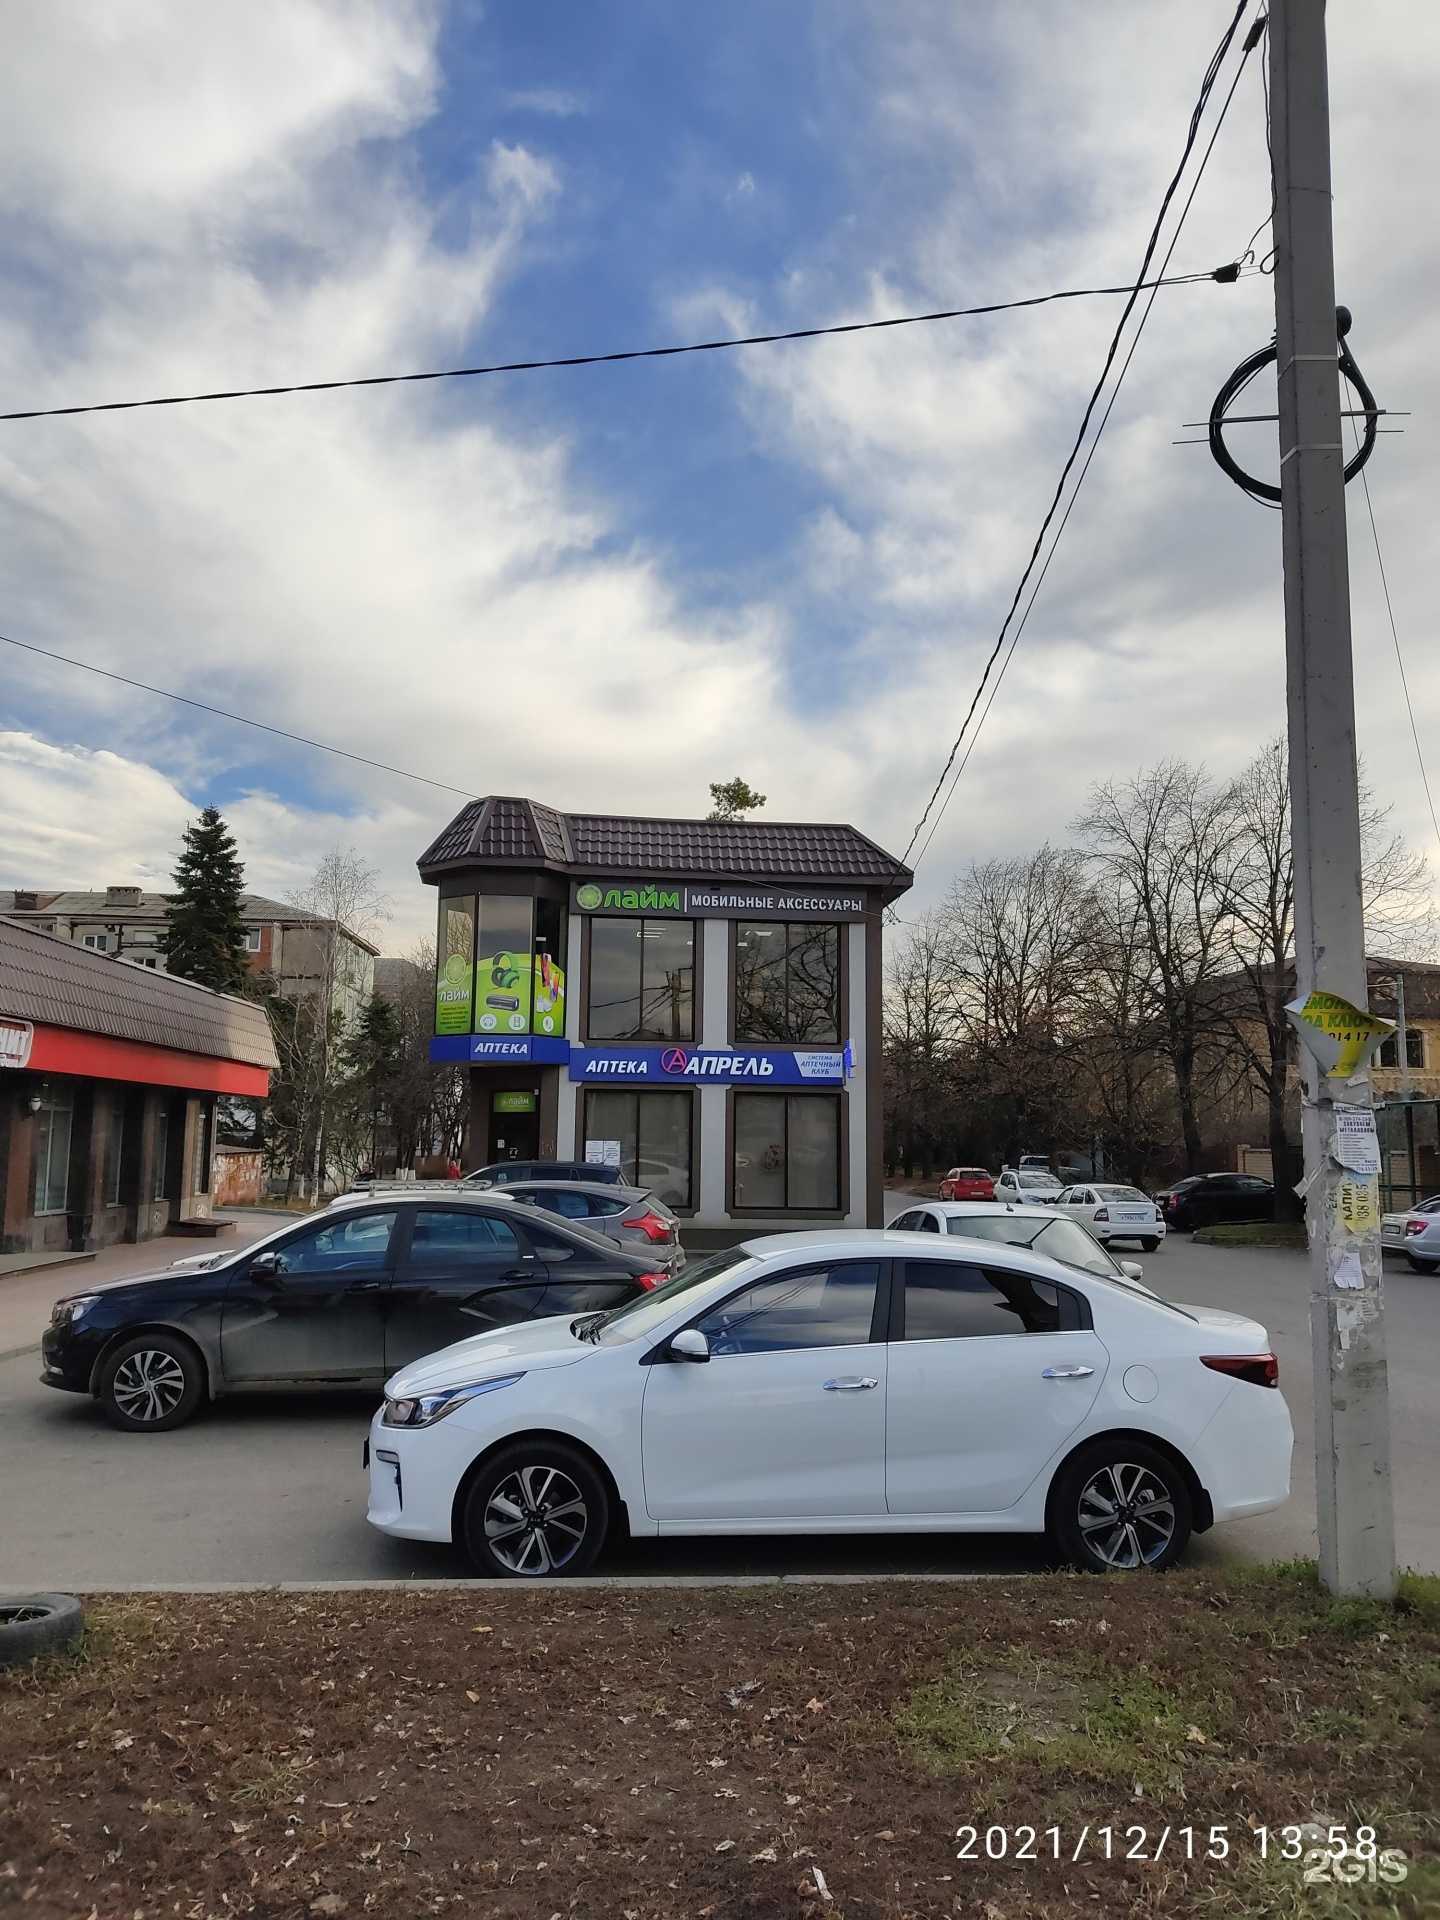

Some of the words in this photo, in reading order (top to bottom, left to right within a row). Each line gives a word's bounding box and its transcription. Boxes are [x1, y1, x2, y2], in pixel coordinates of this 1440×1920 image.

[603, 883, 680, 910] лайм
[691, 894, 774, 909] МОБИЛЬНЫЕ
[777, 898, 863, 912] АКСЕССУАРЫ
[474, 1042, 529, 1055] АПТЕКА
[585, 1059, 648, 1075] АПТЕКА
[684, 1056, 774, 1076] АПРЕЛЬ
